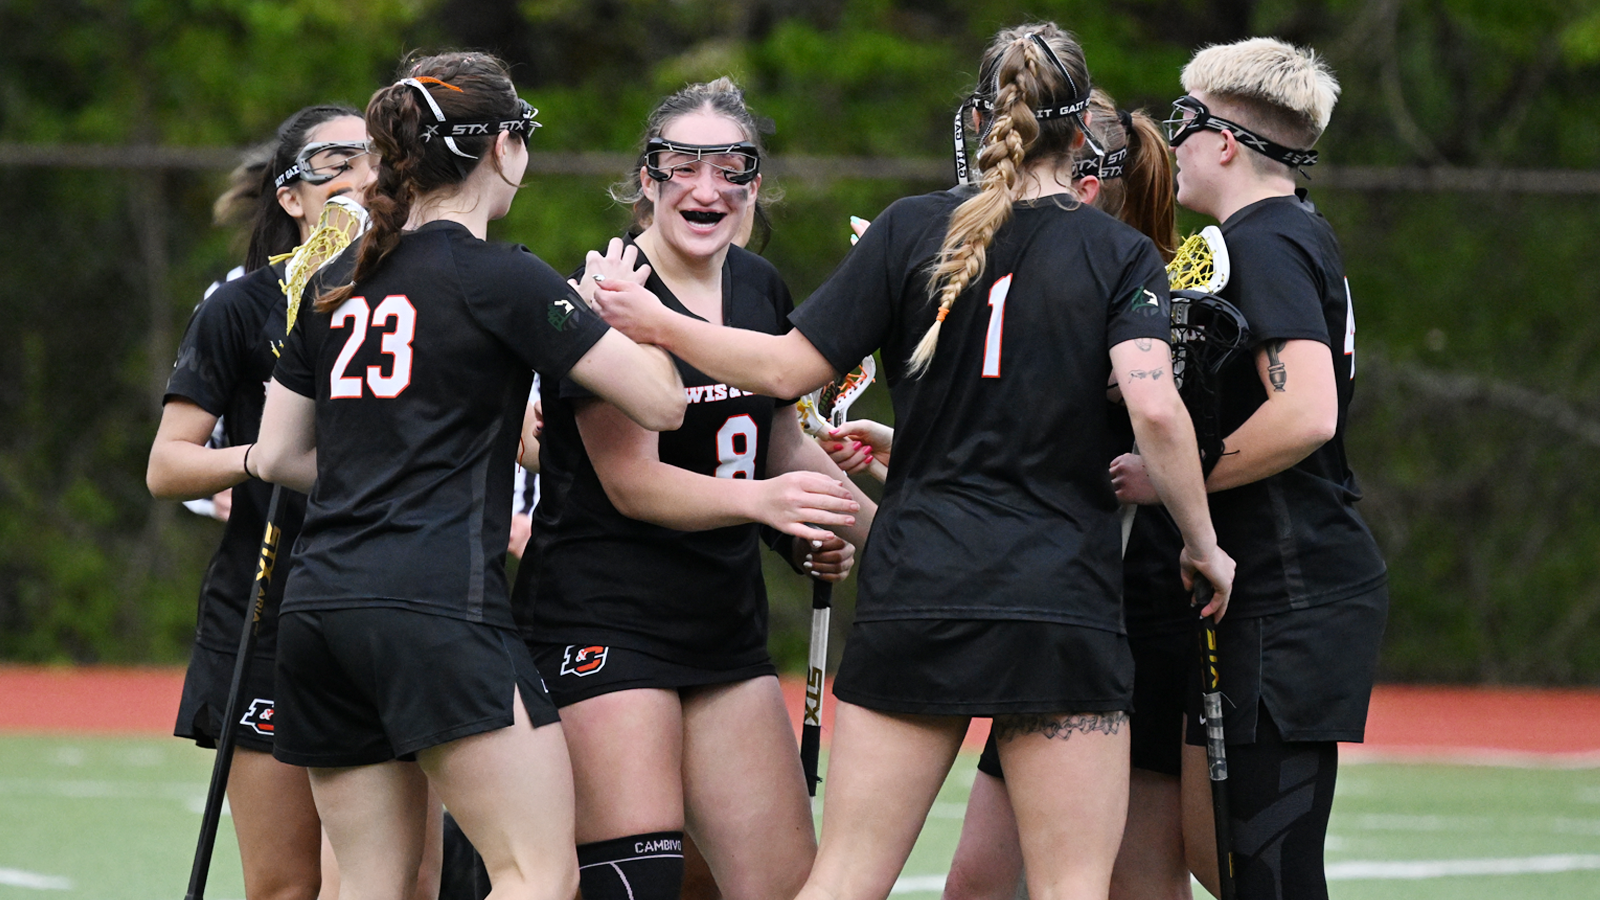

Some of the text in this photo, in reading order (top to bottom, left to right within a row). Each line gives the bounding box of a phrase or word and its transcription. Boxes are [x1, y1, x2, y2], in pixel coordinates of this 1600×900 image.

[451, 123, 489, 135] STX
[498, 120, 526, 132] STX
[1059, 101, 1084, 115] GAIT
[1205, 118, 1268, 152] STX
[329, 294, 418, 400] 23
[981, 272, 1014, 378] 1
[713, 413, 759, 480] 8
[255, 521, 282, 584] STX
[804, 666, 823, 726] STX
